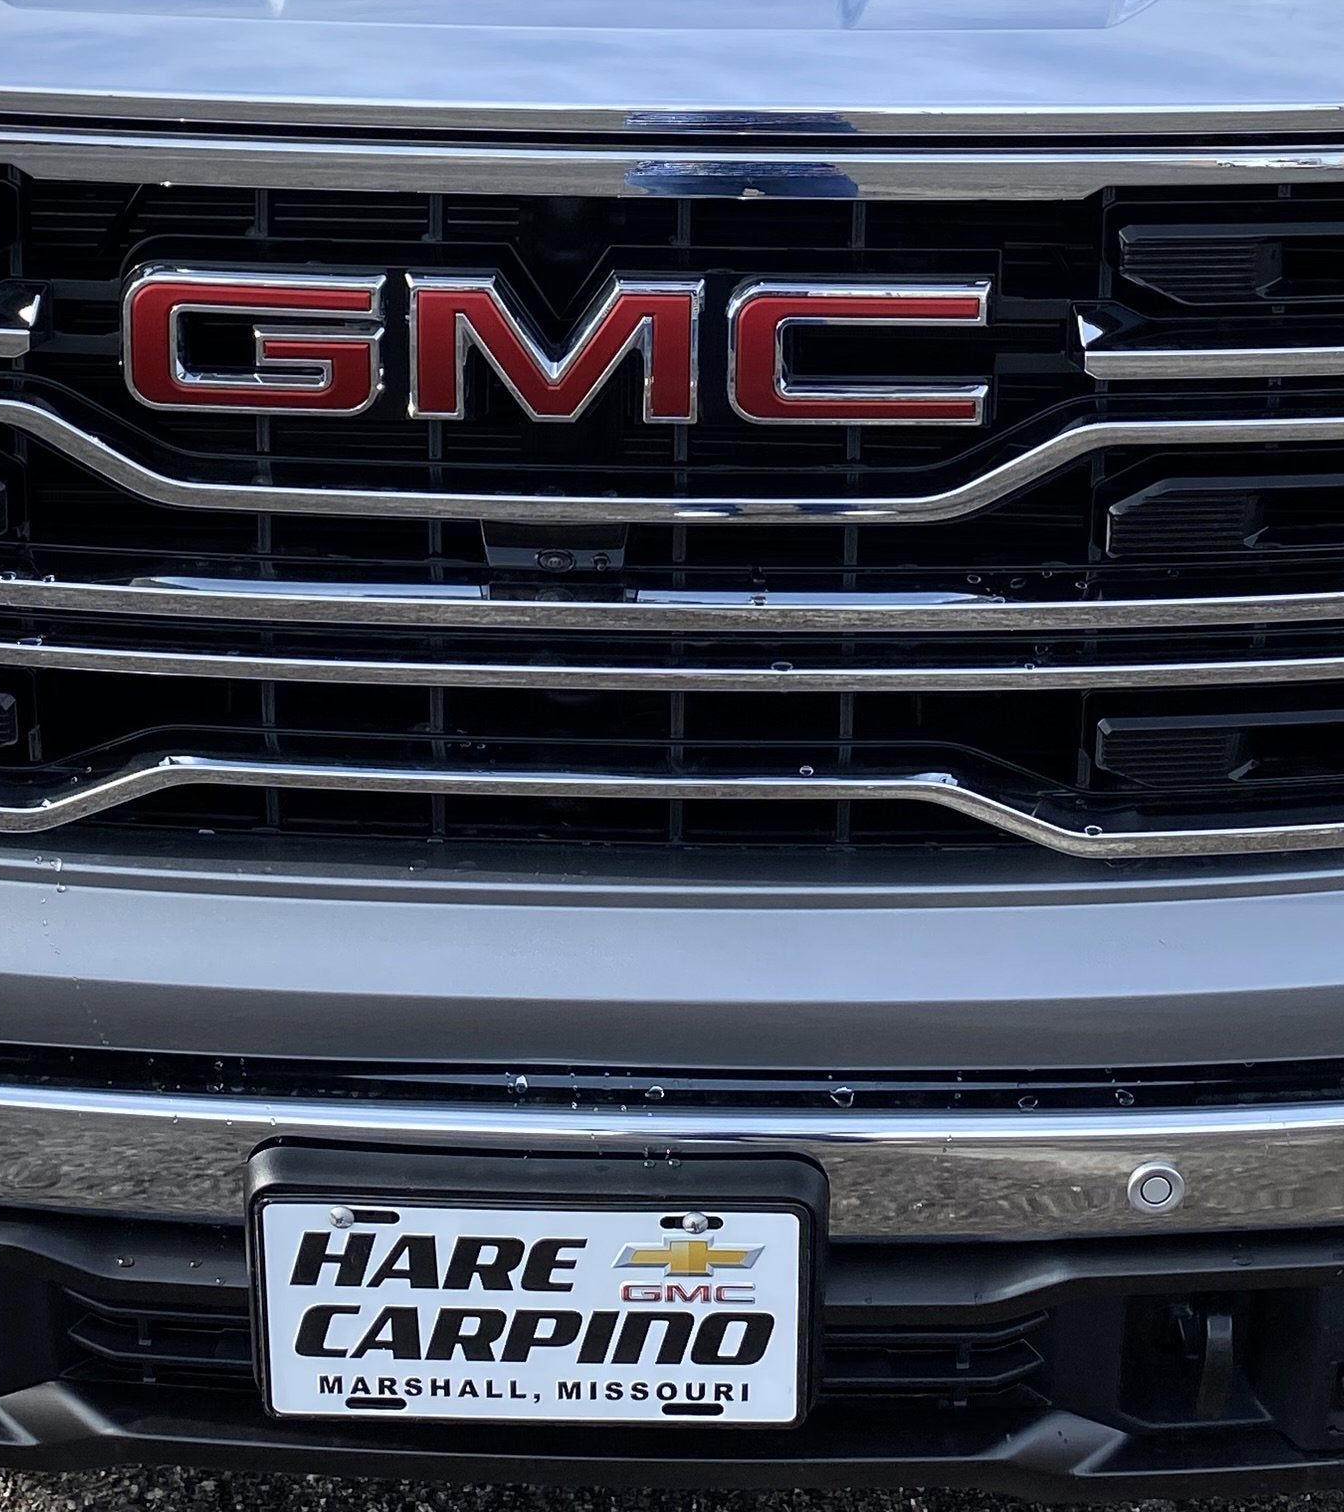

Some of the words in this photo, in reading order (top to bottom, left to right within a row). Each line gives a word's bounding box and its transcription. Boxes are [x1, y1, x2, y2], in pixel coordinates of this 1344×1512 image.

[120, 262, 991, 424] GMC
[289, 1231, 588, 1292] HARE
[620, 1282, 757, 1304] GMC
[294, 1304, 775, 1365] CARPINO
[319, 1375, 542, 1404] MARSHALL,
[557, 1380, 750, 1402] MISSOURI
